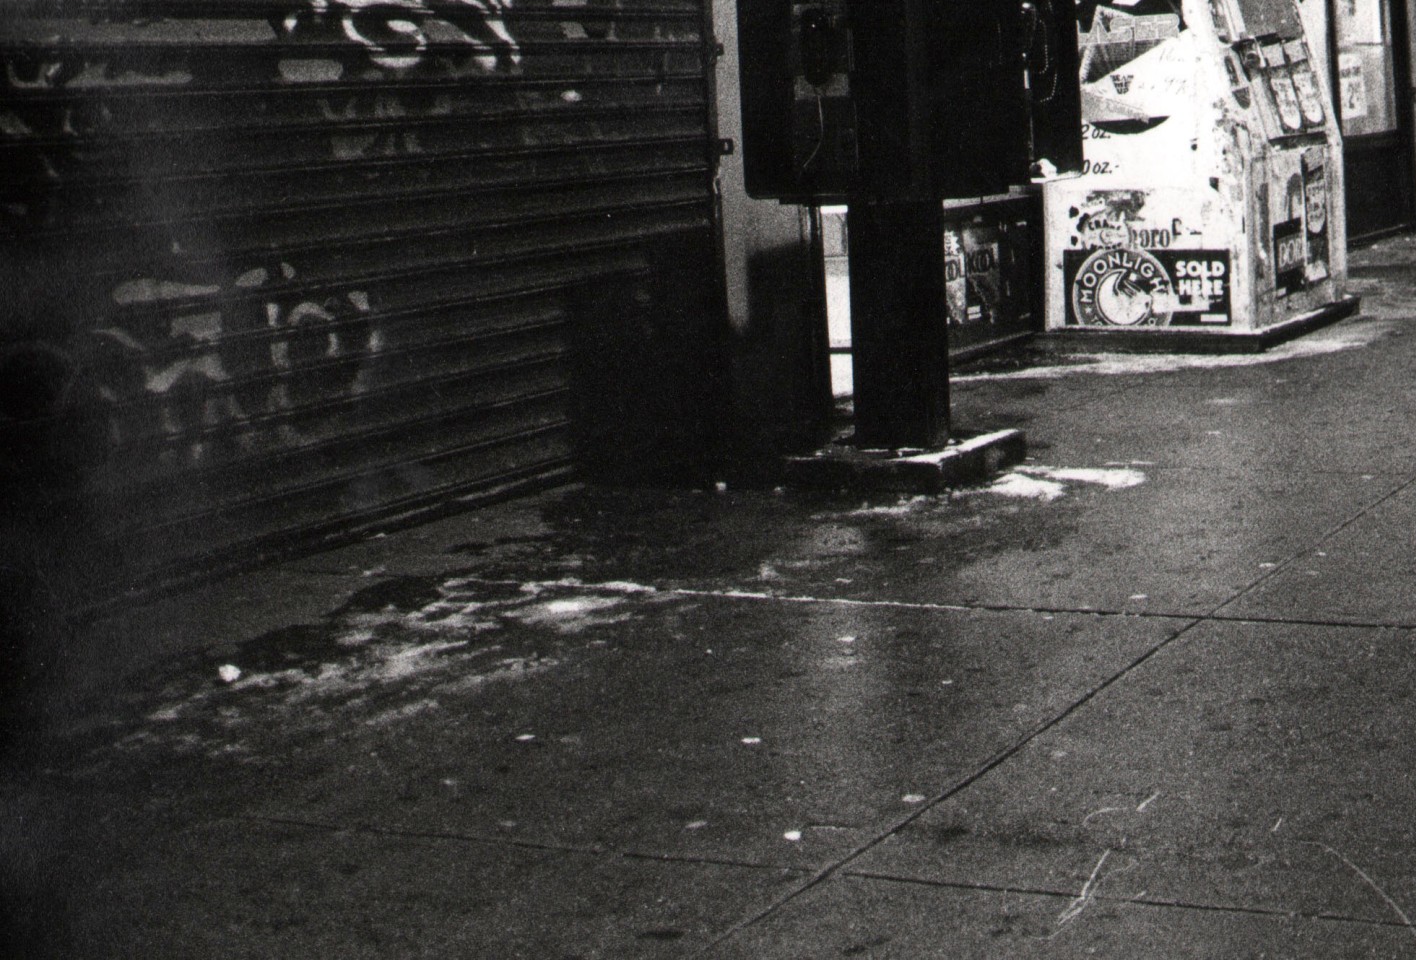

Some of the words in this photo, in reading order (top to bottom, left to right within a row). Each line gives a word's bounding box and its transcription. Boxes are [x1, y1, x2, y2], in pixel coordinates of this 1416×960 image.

[1080, 251, 1166, 304] MOONLIGH
[1175, 260, 1226, 278] SOLD
[1178, 279, 1225, 296] HERE
